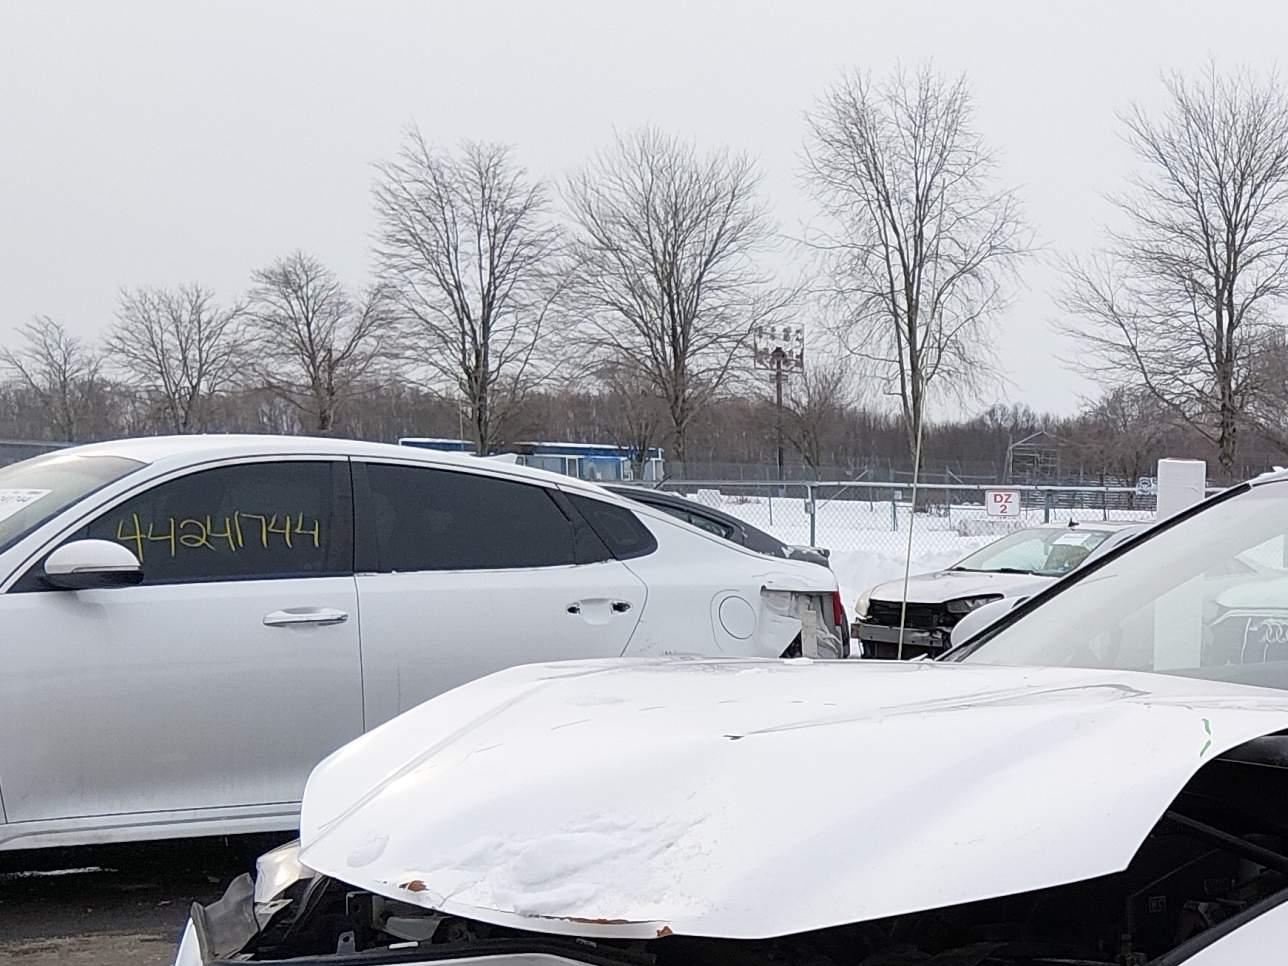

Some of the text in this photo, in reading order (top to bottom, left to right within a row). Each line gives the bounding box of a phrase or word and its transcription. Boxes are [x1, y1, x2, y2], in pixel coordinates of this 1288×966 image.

[993, 494, 1013, 503] DZ
[1000, 504, 1008, 514] 2
[117, 510, 320, 563] 44241744
